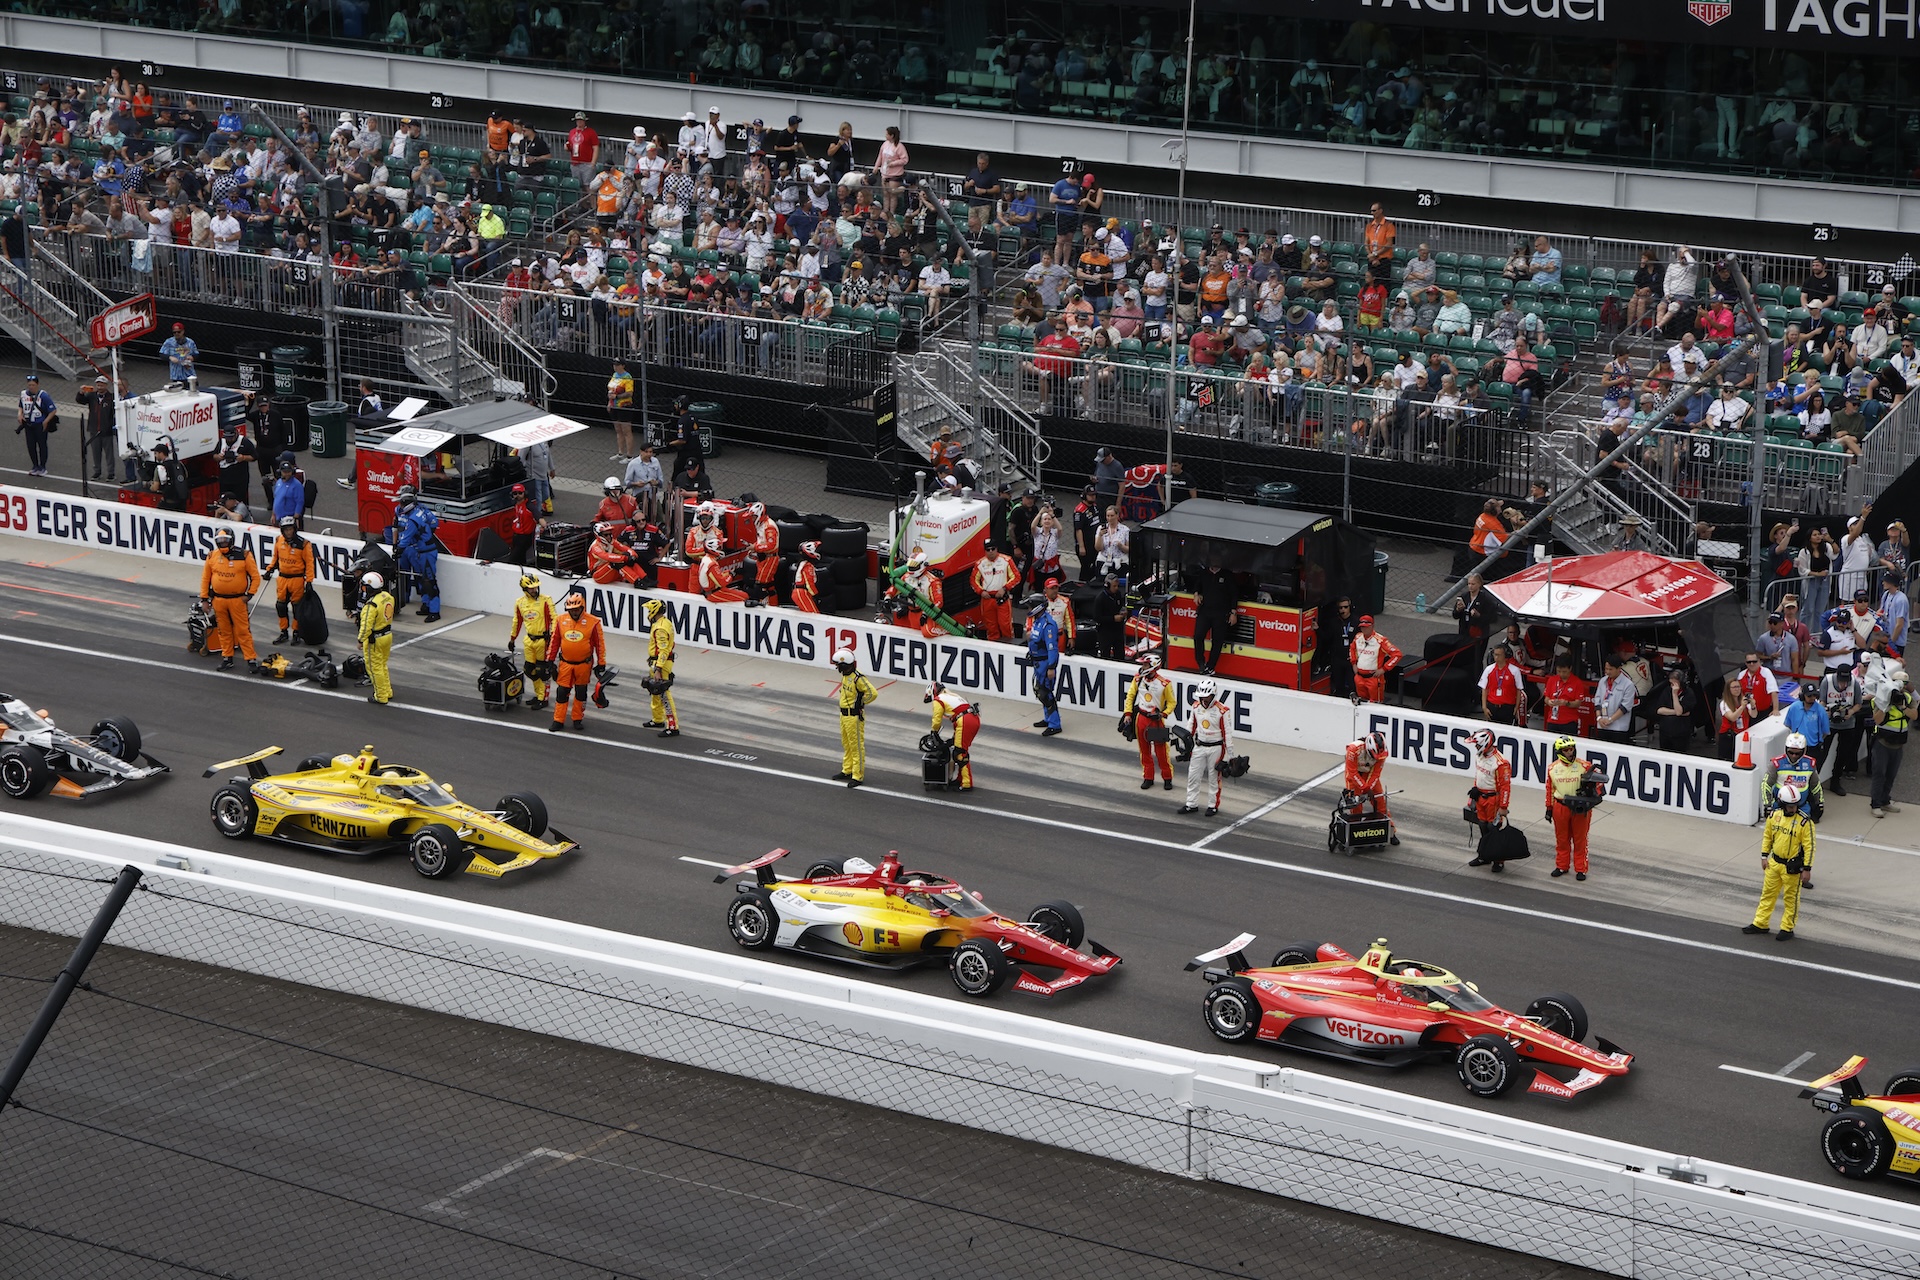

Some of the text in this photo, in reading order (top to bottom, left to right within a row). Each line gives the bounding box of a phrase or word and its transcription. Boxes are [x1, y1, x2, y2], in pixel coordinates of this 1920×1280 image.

[1690, 4, 1729, 24] HEUER
[1764, 0, 1920, 39] AGH
[142, 64, 153, 76] 30
[5, 76, 17, 89] 35
[431, 96, 442, 108] 29
[736, 128, 747, 140] 28
[1062, 161, 1075, 173] 27
[949, 183, 963, 196] 30
[1417, 194, 1431, 206] 26
[1813, 227, 1829, 240] 25
[294, 267, 307, 281] 33
[1867, 270, 1884, 284] 28
[561, 303, 574, 317] 31
[119, 318, 143, 336] SlimFast
[743, 326, 758, 341] 30
[1149, 328, 1159, 338] 10
[1197, 386, 1212, 408] 12
[168, 402, 214, 432] SlimFast
[877, 411, 894, 426] verizon
[510, 421, 574, 443] SlimFast
[1693, 442, 1711, 458] 28
[366, 470, 395, 485] SlimFast
[0, 493, 28, 532] 33
[36, 499, 88, 542] ECR
[96, 509, 219, 562] SLIMFAS
[915, 519, 942, 529] verizon
[947, 515, 977, 535] verizon
[1312, 518, 1333, 533] verizon
[983, 568, 1005, 576] verzon
[1639, 574, 1698, 603] Firestone
[1171, 606, 1197, 618] veriz
[1258, 618, 1297, 633] verizon
[667, 600, 815, 661] MALUKAS
[865, 632, 1004, 693] VERIZON
[1014, 656, 1105, 709] TAM
[1369, 714, 1558, 785] FIRESON
[358, 757, 367, 771] 3
[261, 814, 278, 822] XPEL
[310, 814, 371, 838] PENNZOIL
[1352, 828, 1385, 839] verizon
[1771, 825, 1798, 838] OFFICIAL
[470, 863, 501, 876] HITACHI
[881, 863, 891, 878] 2
[823, 889, 856, 899] Gallagher
[1366, 951, 1382, 968] 12
[1018, 980, 1052, 995] Astemo
[1306, 975, 1343, 986] Gallagher
[1220, 987, 1248, 1004] Firestone
[1376, 996, 1399, 1006] V-Power
[1325, 1017, 1405, 1046] verizon
[1533, 1082, 1572, 1098] HITACHI
[1863, 1144, 1880, 1174] Firestone
